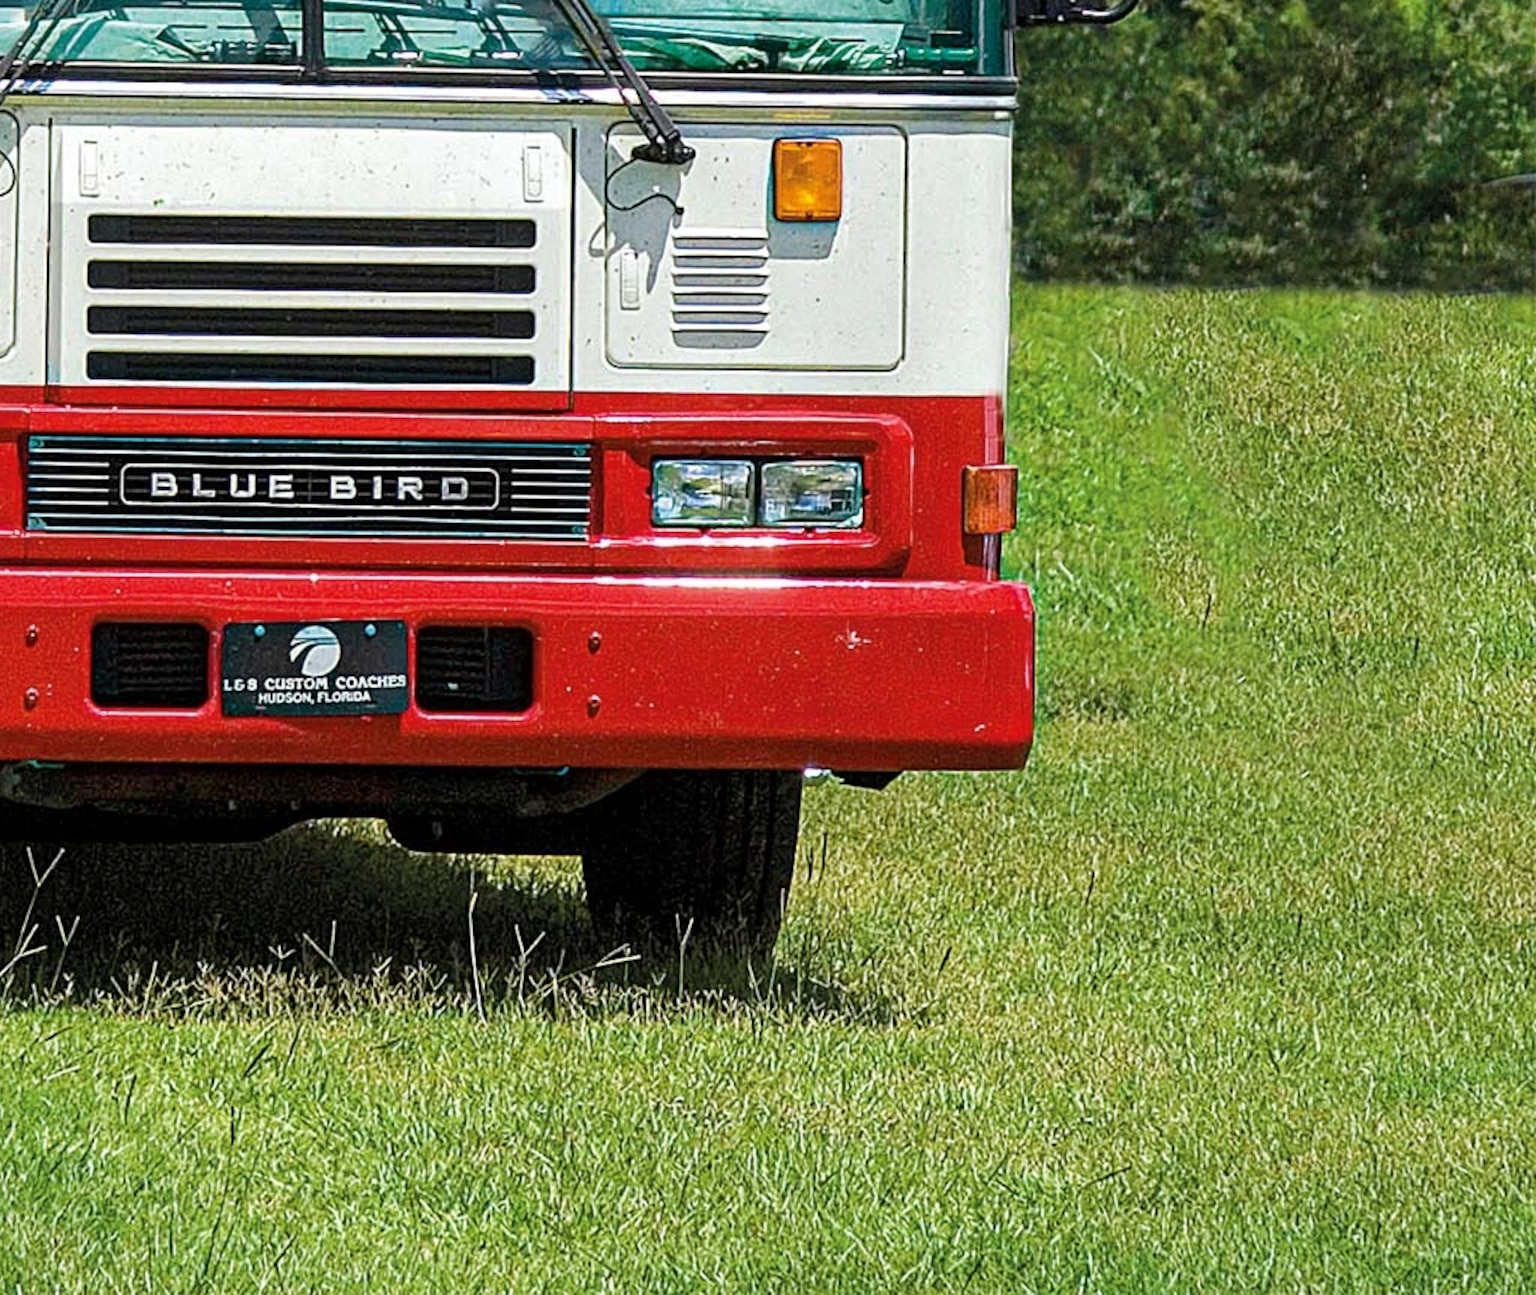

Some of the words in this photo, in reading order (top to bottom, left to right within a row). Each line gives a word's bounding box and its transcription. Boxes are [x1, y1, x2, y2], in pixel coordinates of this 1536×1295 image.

[150, 472, 295, 500] BLUE
[329, 473, 470, 502] BIRD
[264, 676, 329, 691] CUSTOM
[334, 674, 407, 690] COACHES
[258, 691, 315, 705] HUDSON,
[316, 690, 372, 704] FLORIDA
